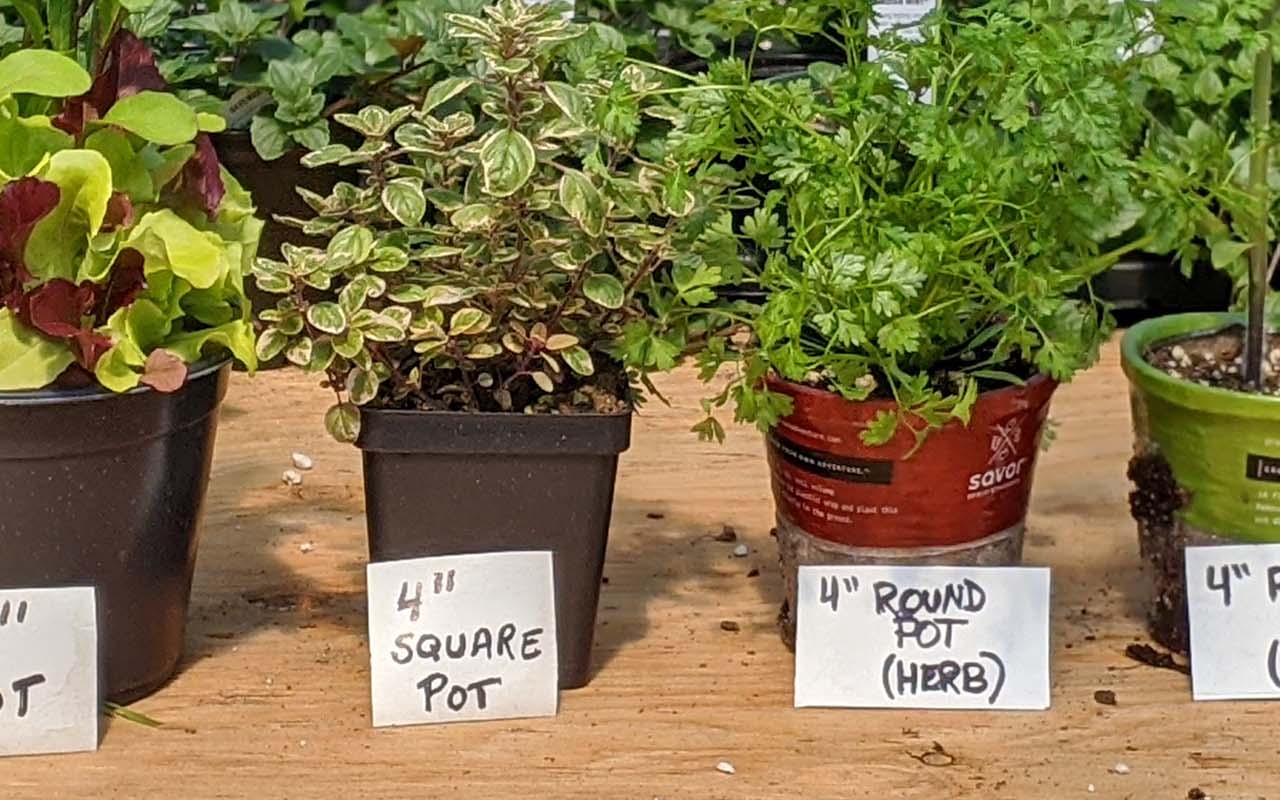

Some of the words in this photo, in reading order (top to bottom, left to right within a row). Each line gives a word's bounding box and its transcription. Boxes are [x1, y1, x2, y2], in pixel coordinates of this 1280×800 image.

[967, 457, 1027, 491] savor
[397, 568, 456, 622] 4"
[820, 575, 859, 612] 4"
[872, 578, 986, 615] ROUND
[1206, 562, 1251, 607] 4"
[390, 622, 544, 664] SQUARE
[893, 615, 969, 649] POT
[416, 672, 503, 713] POT
[882, 651, 1006, 705] (HERB)
